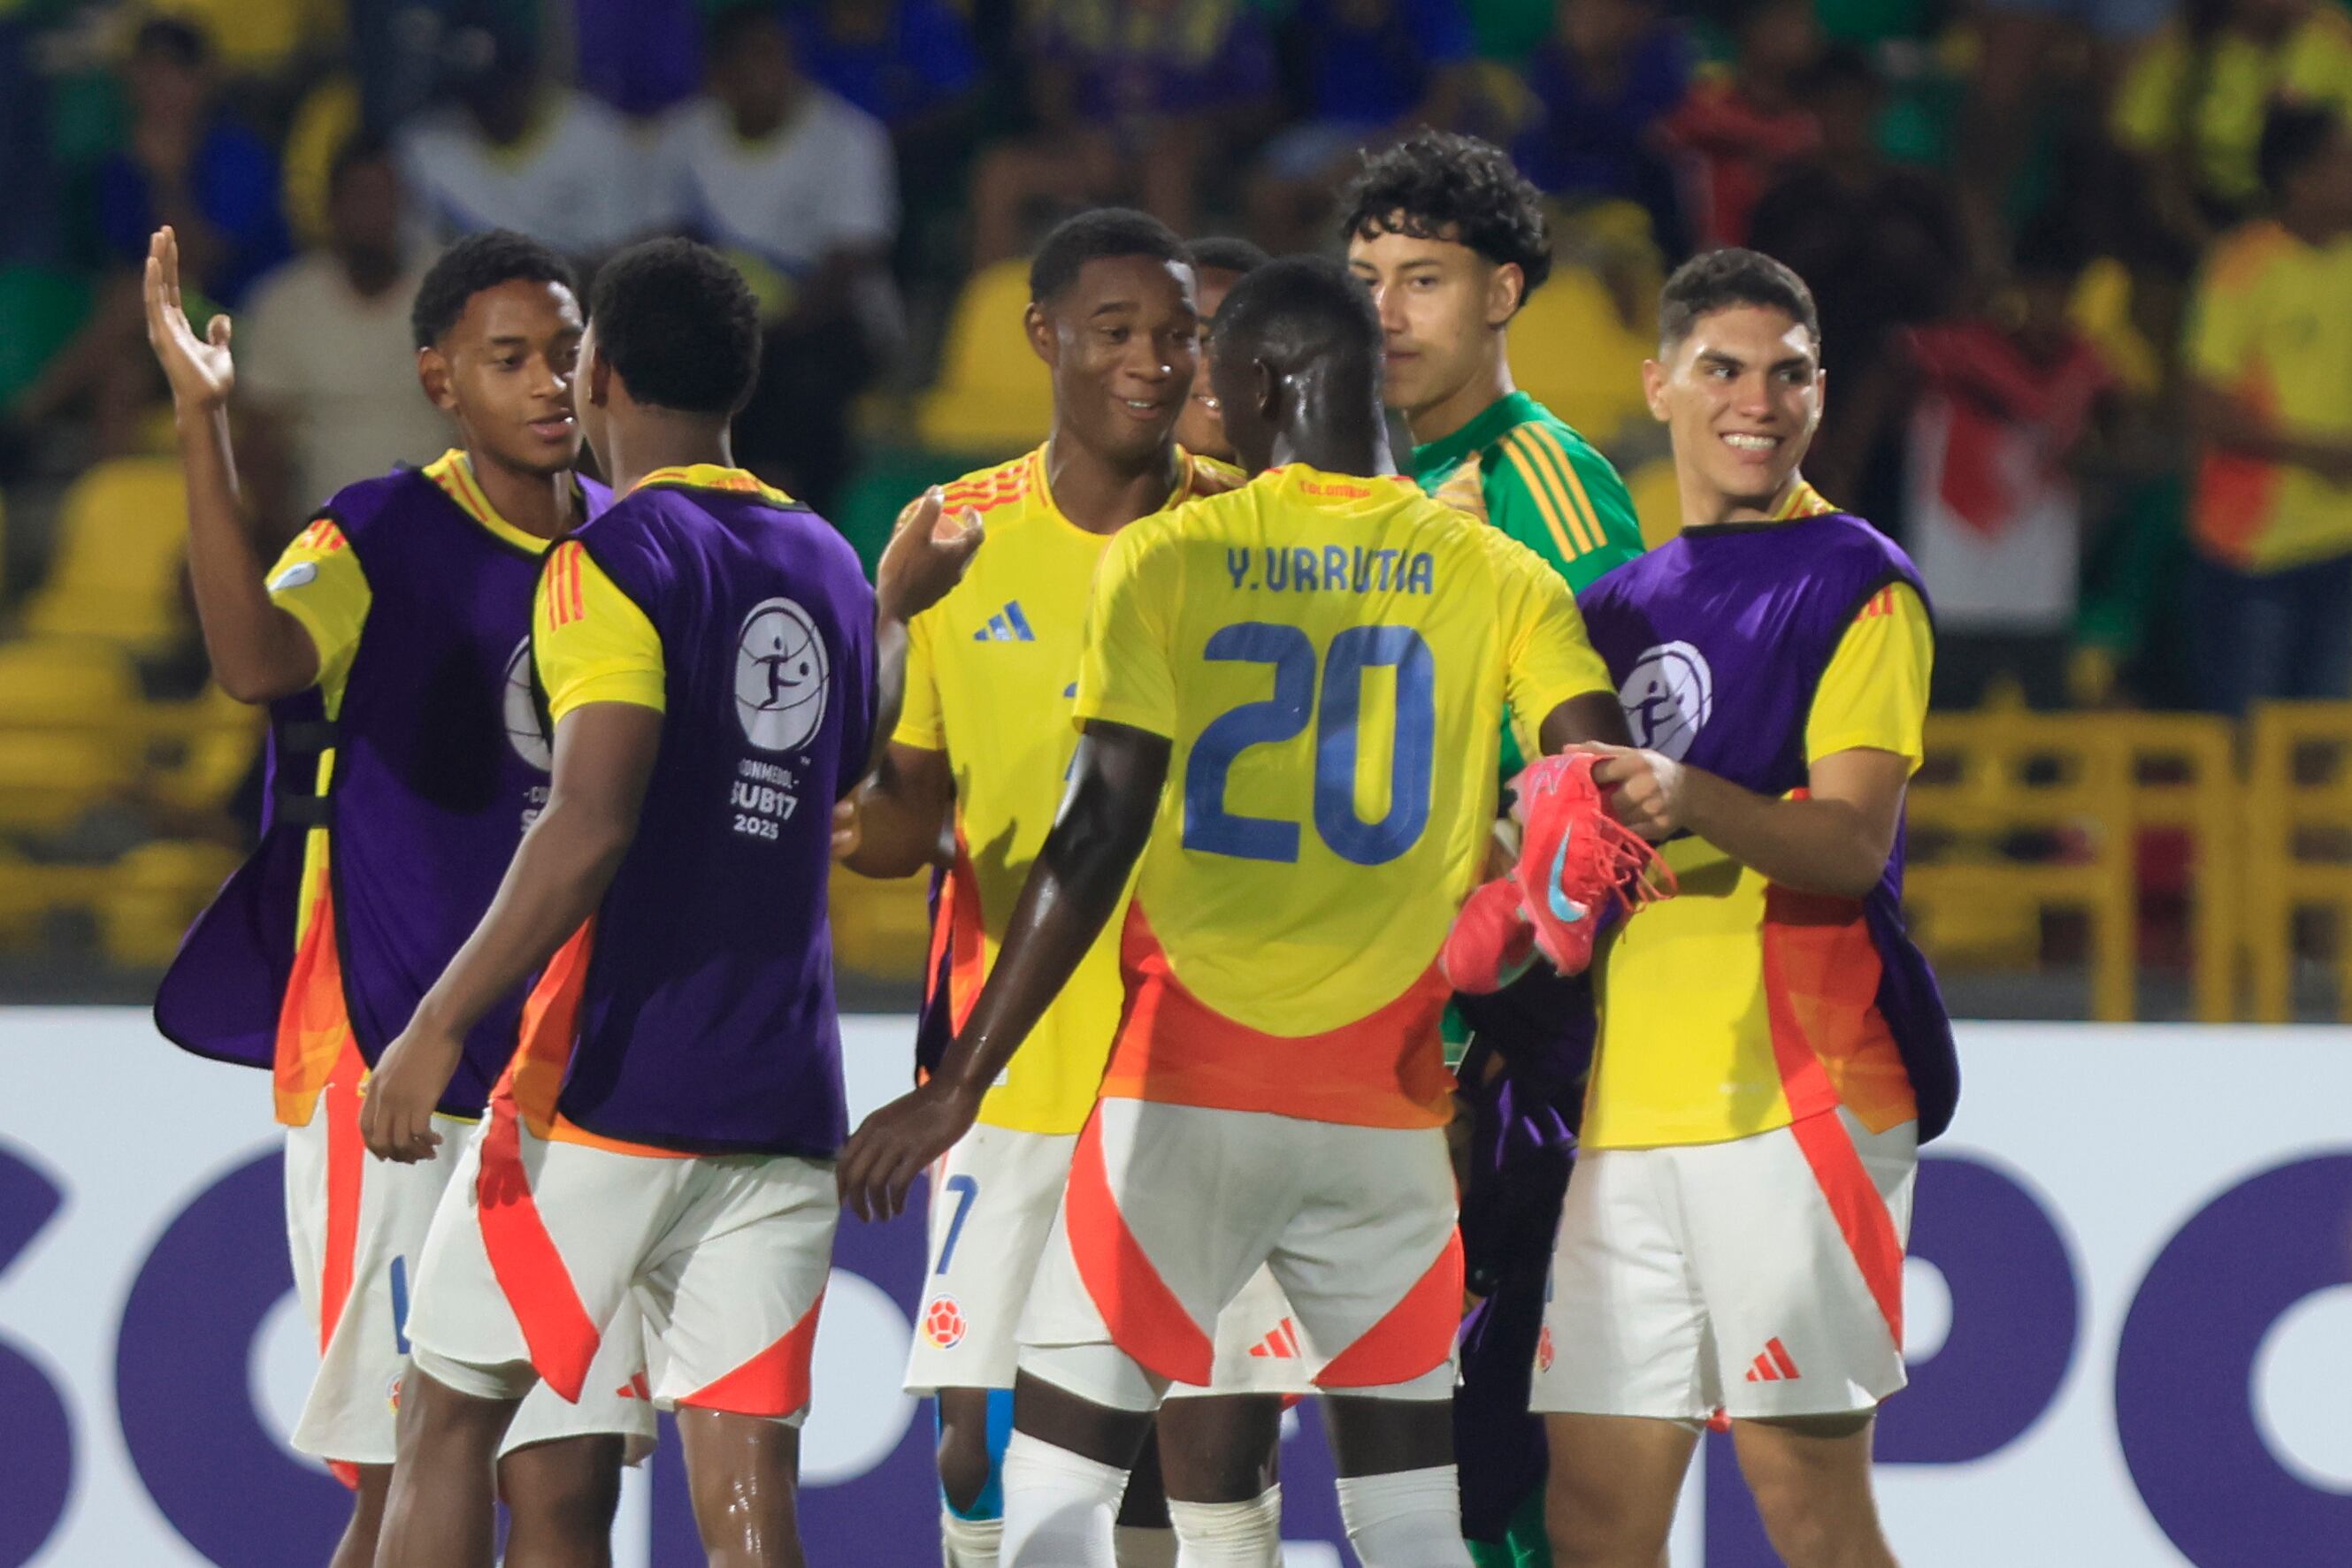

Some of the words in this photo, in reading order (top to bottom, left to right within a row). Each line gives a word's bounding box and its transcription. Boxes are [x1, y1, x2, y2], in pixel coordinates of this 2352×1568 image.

[1227, 545, 1434, 595] Y.URRUTIA
[1183, 622, 1435, 865] 20
[733, 814, 779, 840] 2025
[935, 1174, 979, 1274] 7
